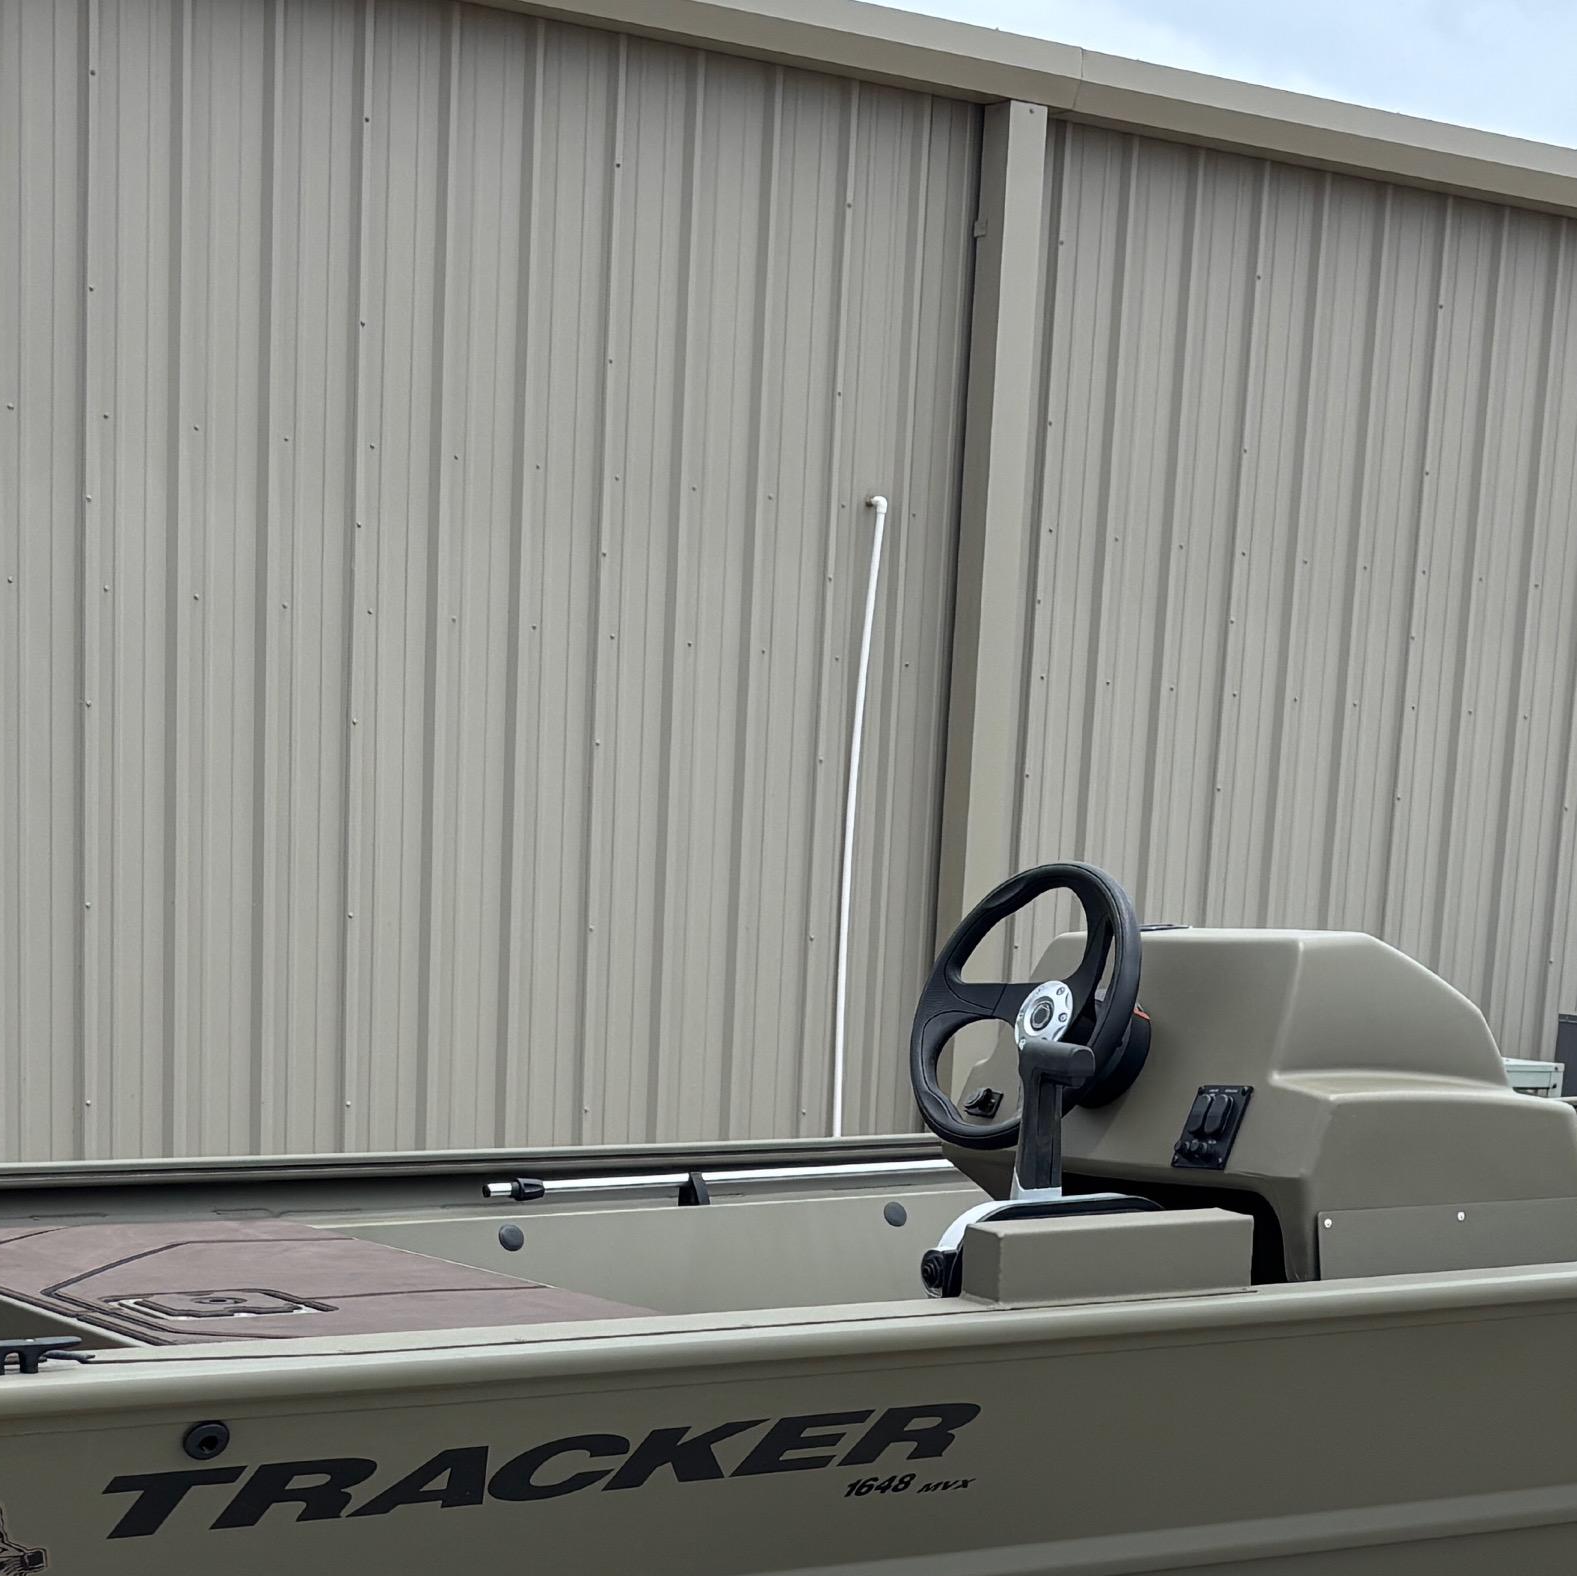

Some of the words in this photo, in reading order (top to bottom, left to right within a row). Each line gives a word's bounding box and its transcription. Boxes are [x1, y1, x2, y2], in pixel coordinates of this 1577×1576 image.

[101, 1402, 982, 1540] TRACKER
[843, 1472, 917, 1498] 1648
[916, 1478, 977, 1494] MVX
